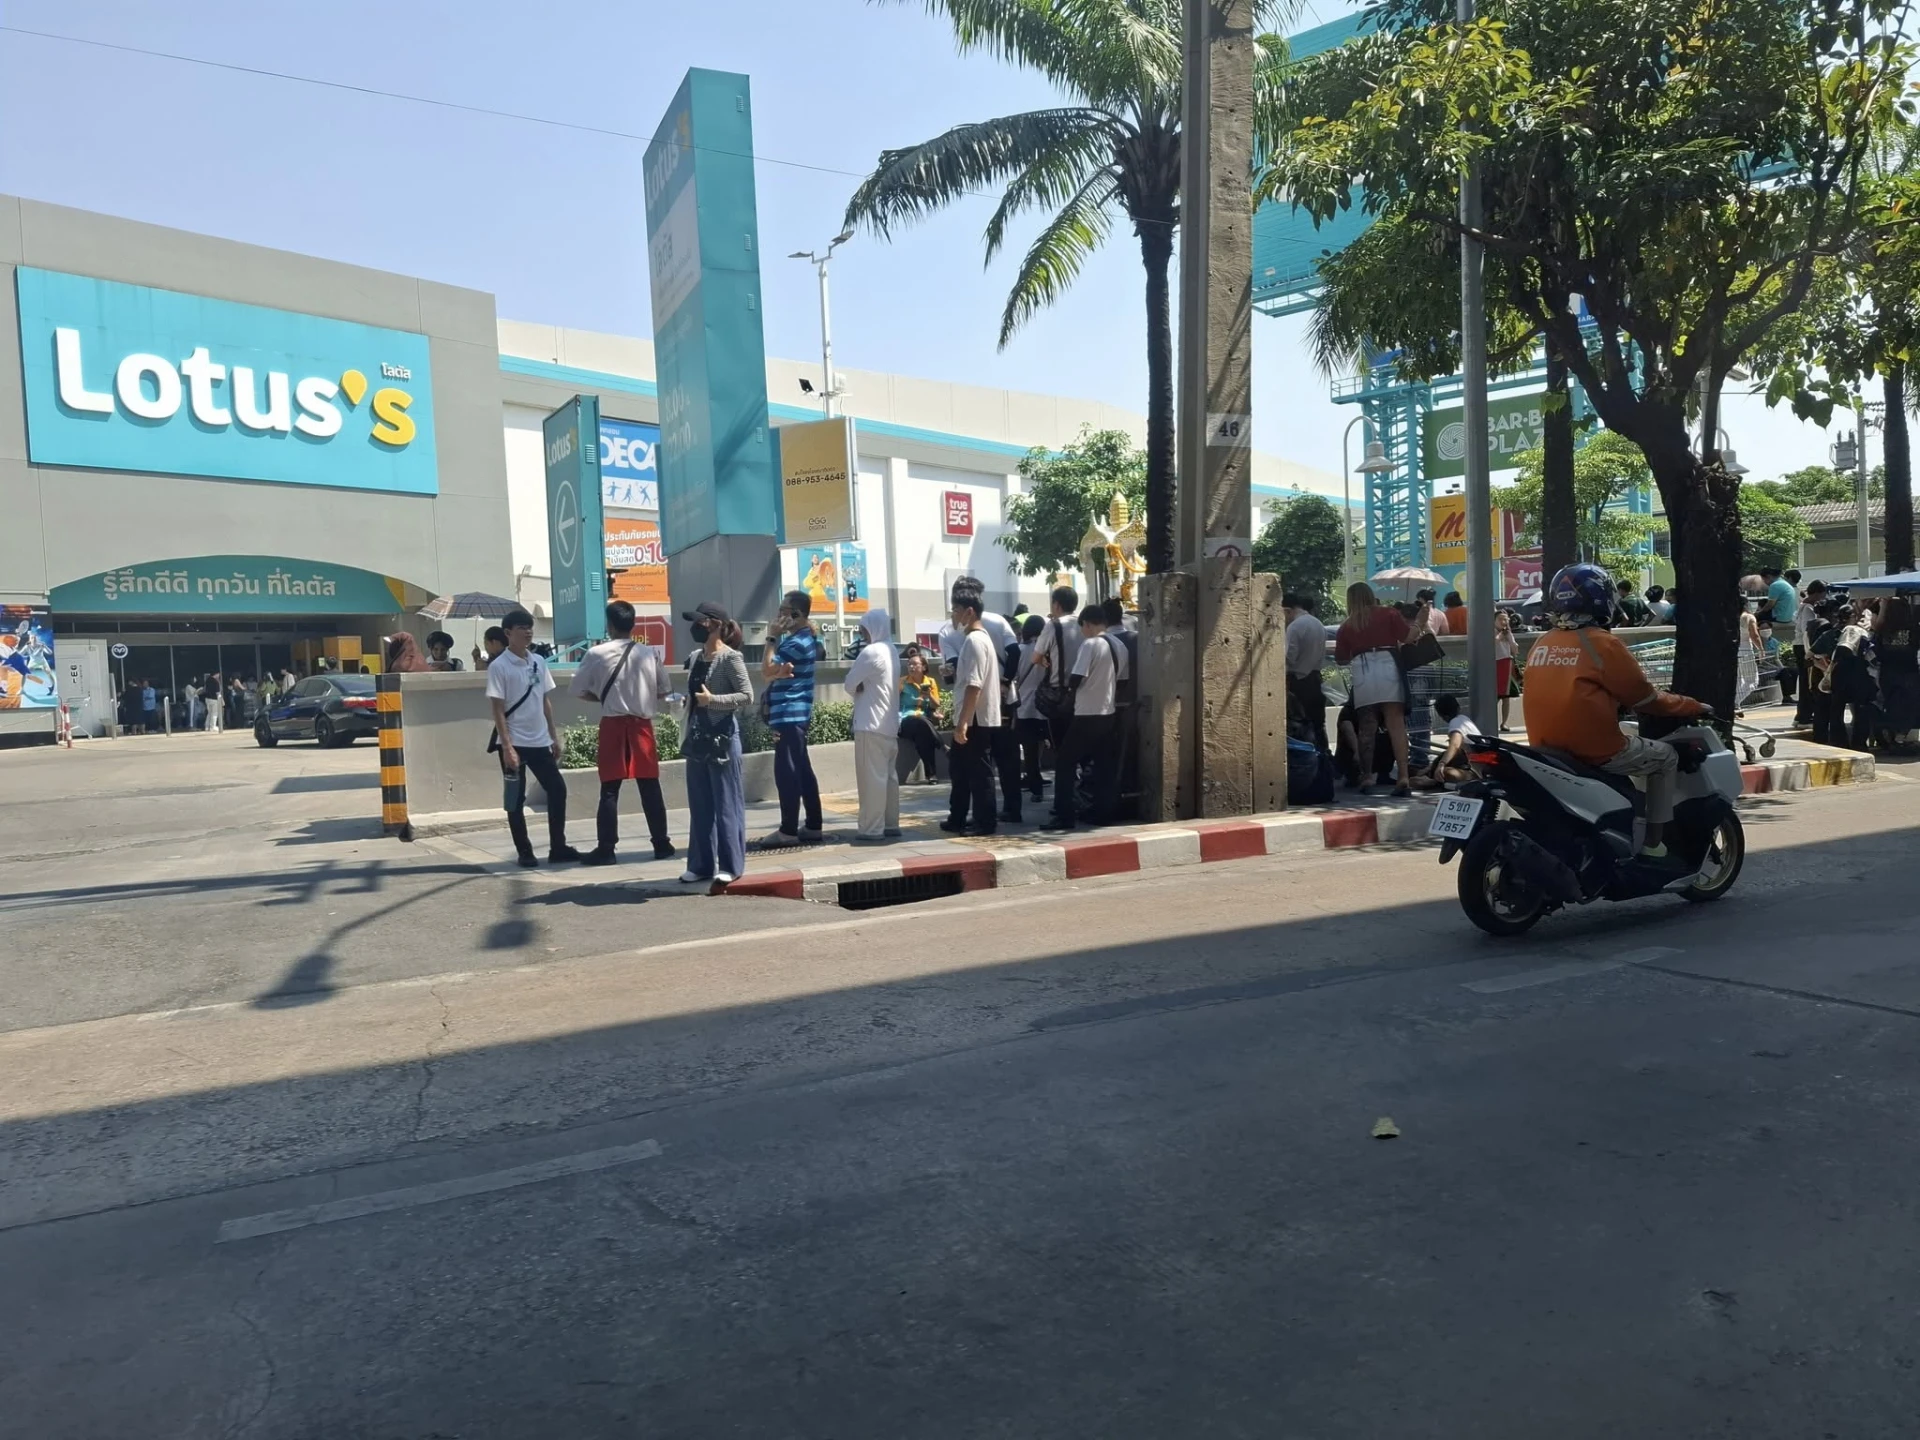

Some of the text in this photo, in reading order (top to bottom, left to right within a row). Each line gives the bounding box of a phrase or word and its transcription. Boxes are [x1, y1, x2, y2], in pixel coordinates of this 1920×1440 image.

[381, 362, 412, 380] โลตัส
[55, 326, 416, 446] Lotus's
[1219, 421, 1240, 437] 46
[546, 427, 577, 467] Lotus's
[1488, 428, 1545, 453] PLAZ
[785, 472, 846, 486] 088-953-4645
[949, 498, 968, 510] true
[949, 510, 969, 526] 5G
[197, 572, 260, 600] ทุกวัน
[267, 568, 336, 596] ที่โลตัส
[1551, 645, 1581, 654] Shopee
[1547, 654, 1579, 665] Food
[1438, 821, 1467, 833] 7857
